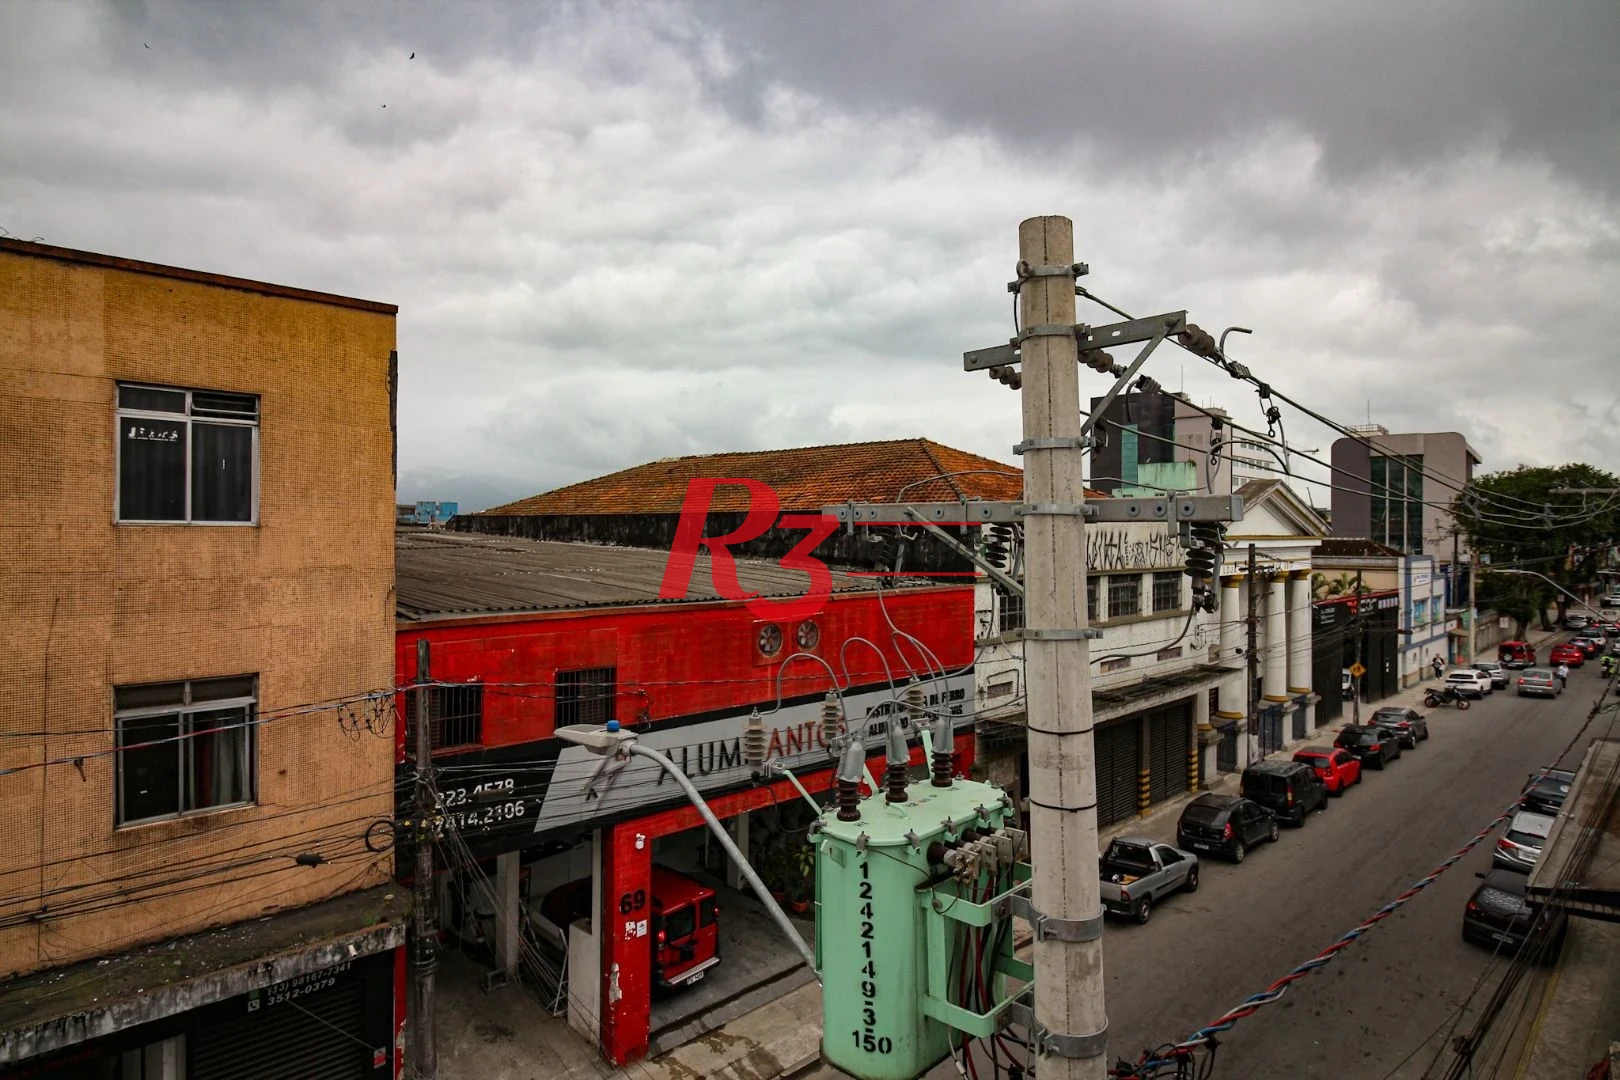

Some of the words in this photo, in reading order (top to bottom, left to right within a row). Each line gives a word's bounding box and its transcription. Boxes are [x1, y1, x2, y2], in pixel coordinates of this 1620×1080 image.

[941, 688, 965, 704] FRRO
[619, 888, 646, 916] 69
[852, 1030, 892, 1055] 150
